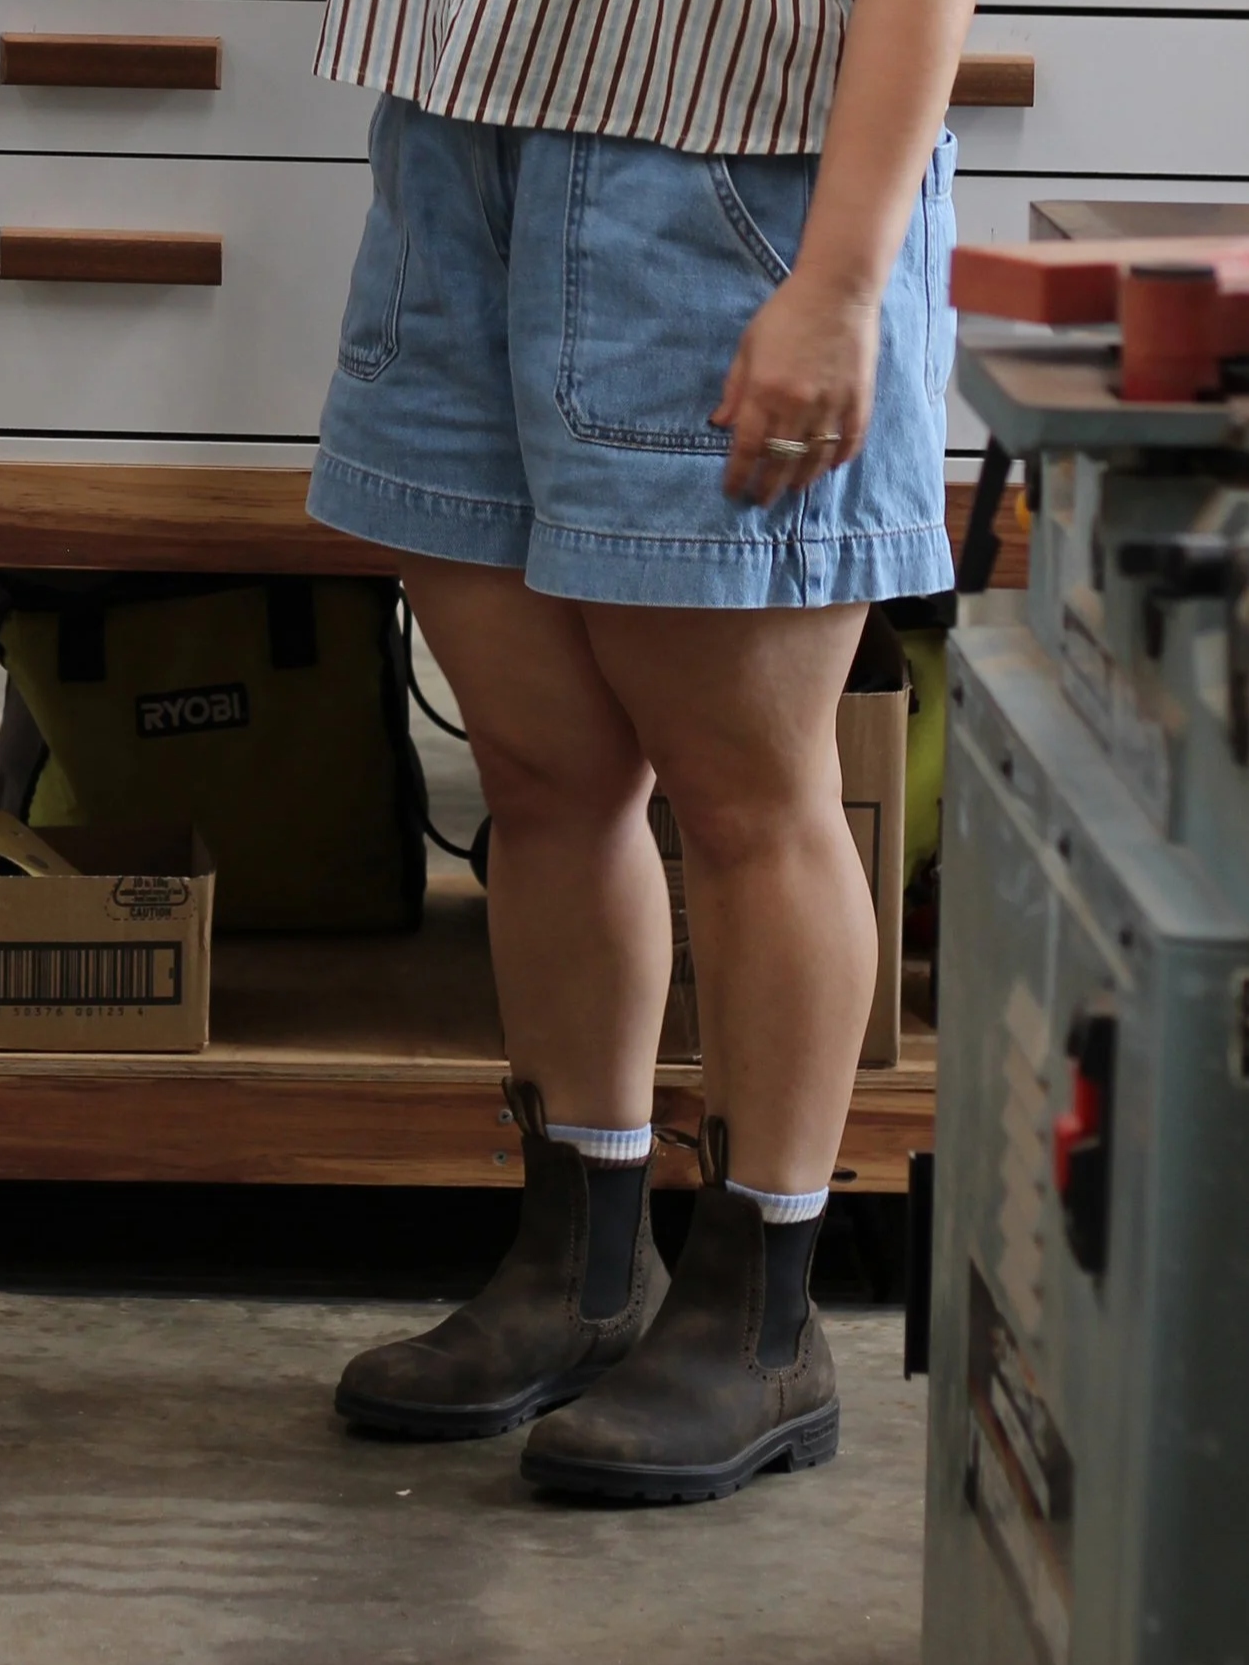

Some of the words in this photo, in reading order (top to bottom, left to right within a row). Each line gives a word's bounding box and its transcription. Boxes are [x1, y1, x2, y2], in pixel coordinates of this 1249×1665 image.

[141, 691, 240, 730] RYOBI
[130, 907, 171, 917] CAUTION
[13, 1007, 64, 1017] 50376
[75, 1007, 125, 1017] 00125
[137, 1007, 144, 1017] 4
